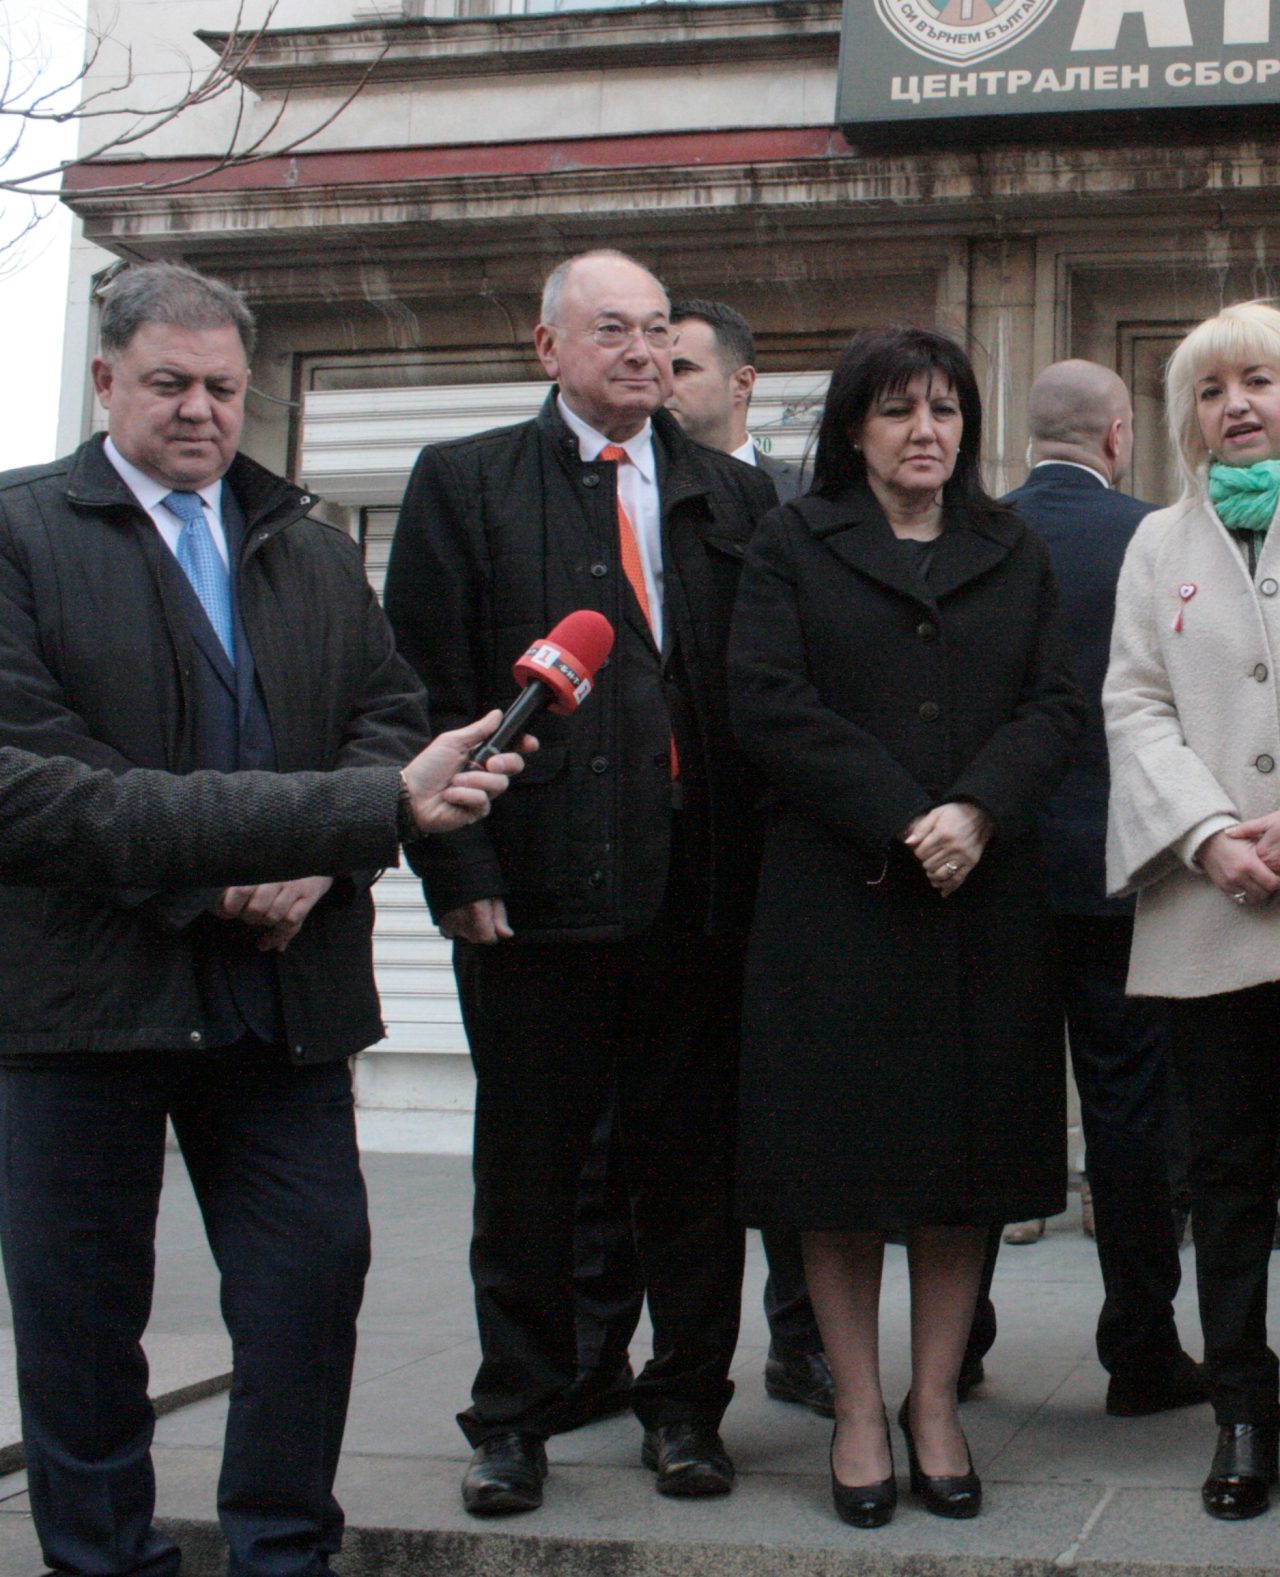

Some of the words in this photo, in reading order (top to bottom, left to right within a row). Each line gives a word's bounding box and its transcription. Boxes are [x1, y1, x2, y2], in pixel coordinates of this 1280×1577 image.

[916, 20, 981, 44] ВЪРНЕМ
[985, 0, 1036, 39] БЪЛГА
[890, 64, 1149, 104] ЦЕНТРАЛЕН
